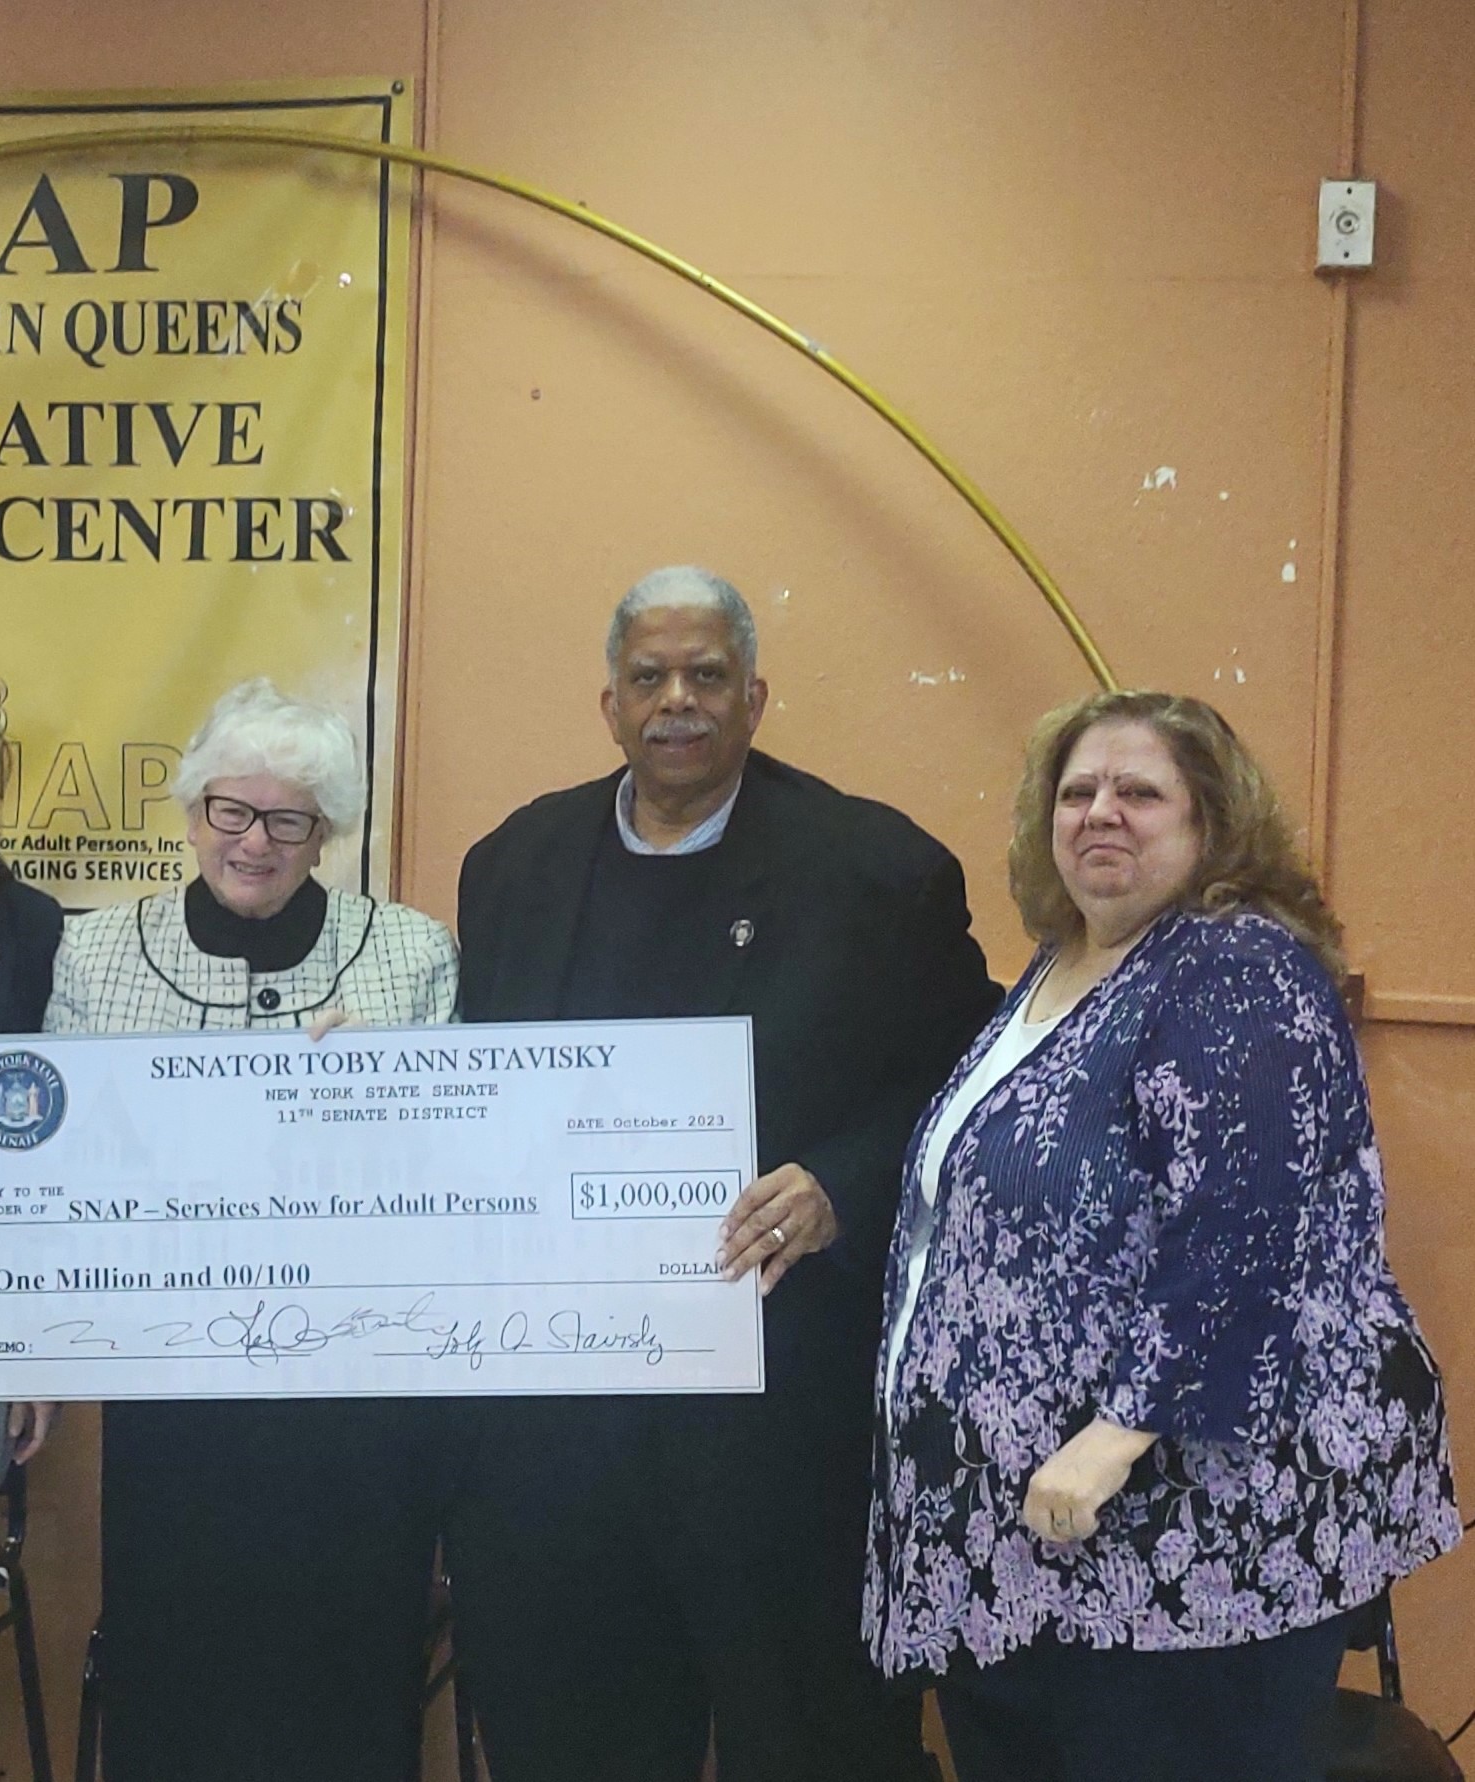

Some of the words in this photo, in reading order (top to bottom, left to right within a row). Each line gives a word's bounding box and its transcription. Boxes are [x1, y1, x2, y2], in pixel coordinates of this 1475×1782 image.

[64, 299, 304, 368] QUEENS
[0, 836, 17, 851] or
[21, 835, 71, 851] Adult
[76, 836, 153, 854] Persons,
[158, 837, 185, 852] Inc
[11, 859, 77, 880] AGING
[85, 861, 183, 881] SERVICES
[150, 1054, 292, 1079] SENATOR
[299, 1049, 386, 1076] TOBY
[393, 1049, 458, 1072] ANN
[468, 1045, 616, 1070] STAVISKY
[266, 1089, 298, 1101] NEW
[310, 1087, 354, 1100] YORK
[366, 1085, 420, 1098] STATE
[432, 1084, 498, 1097] SENATE
[277, 1108, 313, 1123] 11TH
[321, 1108, 387, 1121] SENATE
[399, 1106, 488, 1120] DISTRICT
[567, 1118, 604, 1129] DATE
[613, 1117, 677, 1127] October
[688, 1115, 724, 1126] 2023
[13, 1187, 31, 1197] TO
[39, 1187, 64, 1196] THE
[580, 1181, 727, 1211] $1,000,000
[31, 1205, 47, 1214] OF
[69, 1200, 139, 1222] SNAP
[165, 1197, 260, 1219] Services
[269, 1196, 320, 1217] Now
[331, 1194, 364, 1215] for
[370, 1193, 435, 1214] Adult
[446, 1192, 537, 1212] Persons
[56, 1267, 151, 1289] Million
[164, 1265, 211, 1288] and
[224, 1263, 311, 1286] 00/100
